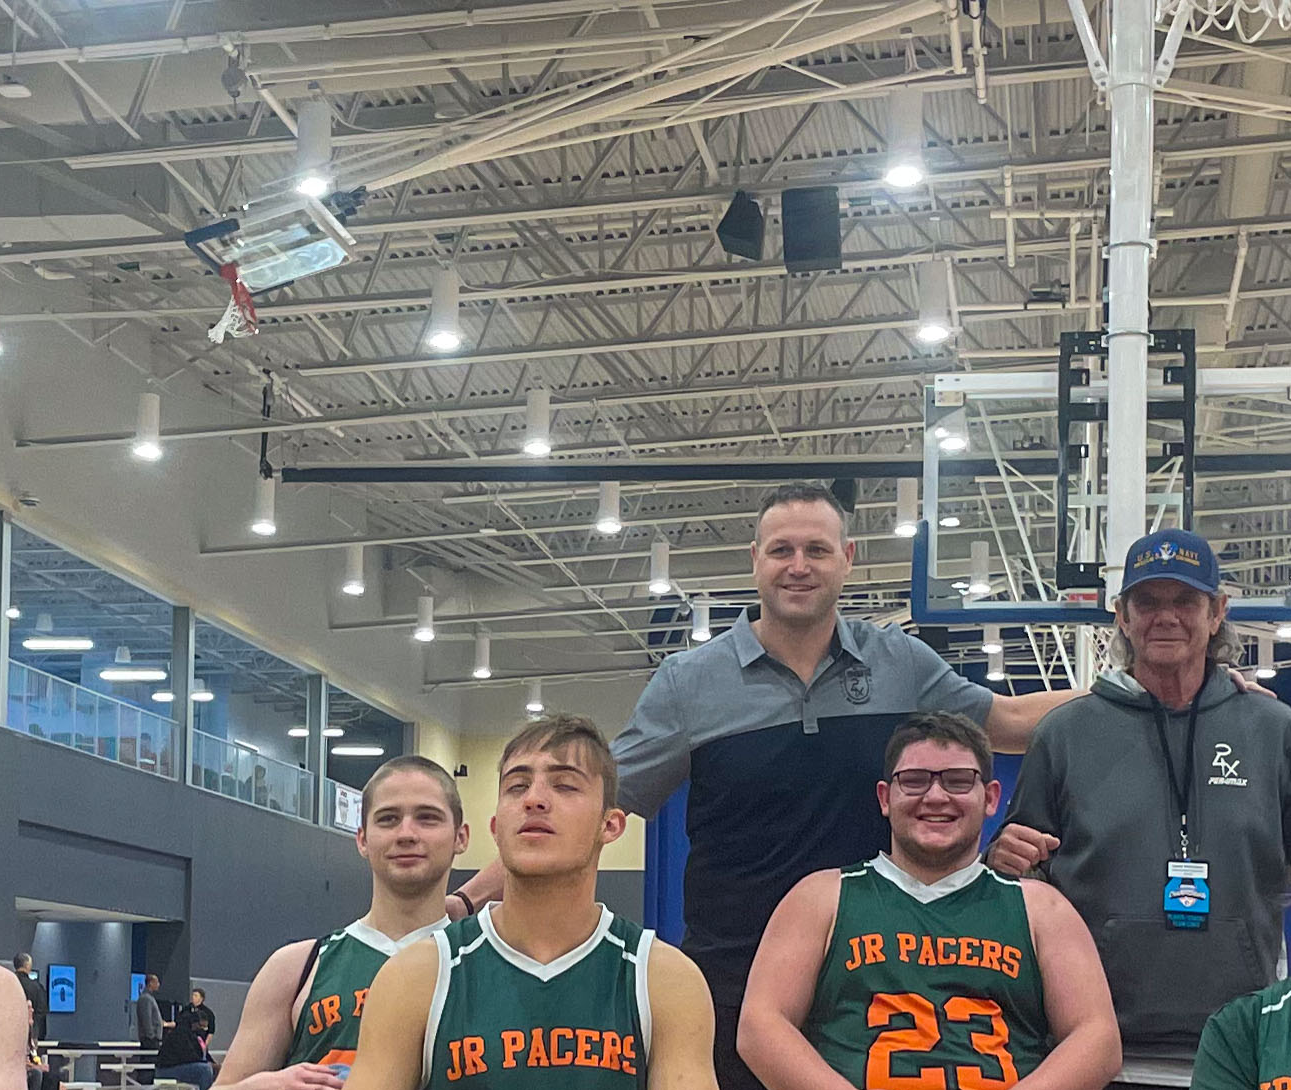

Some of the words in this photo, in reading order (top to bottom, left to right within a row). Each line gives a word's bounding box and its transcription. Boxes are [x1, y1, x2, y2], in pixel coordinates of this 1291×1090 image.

[845, 933, 887, 972] JR
[896, 931, 1023, 979] PACERS
[308, 994, 342, 1035] JR
[446, 1036, 488, 1082] JR
[500, 1026, 637, 1076] PACERS
